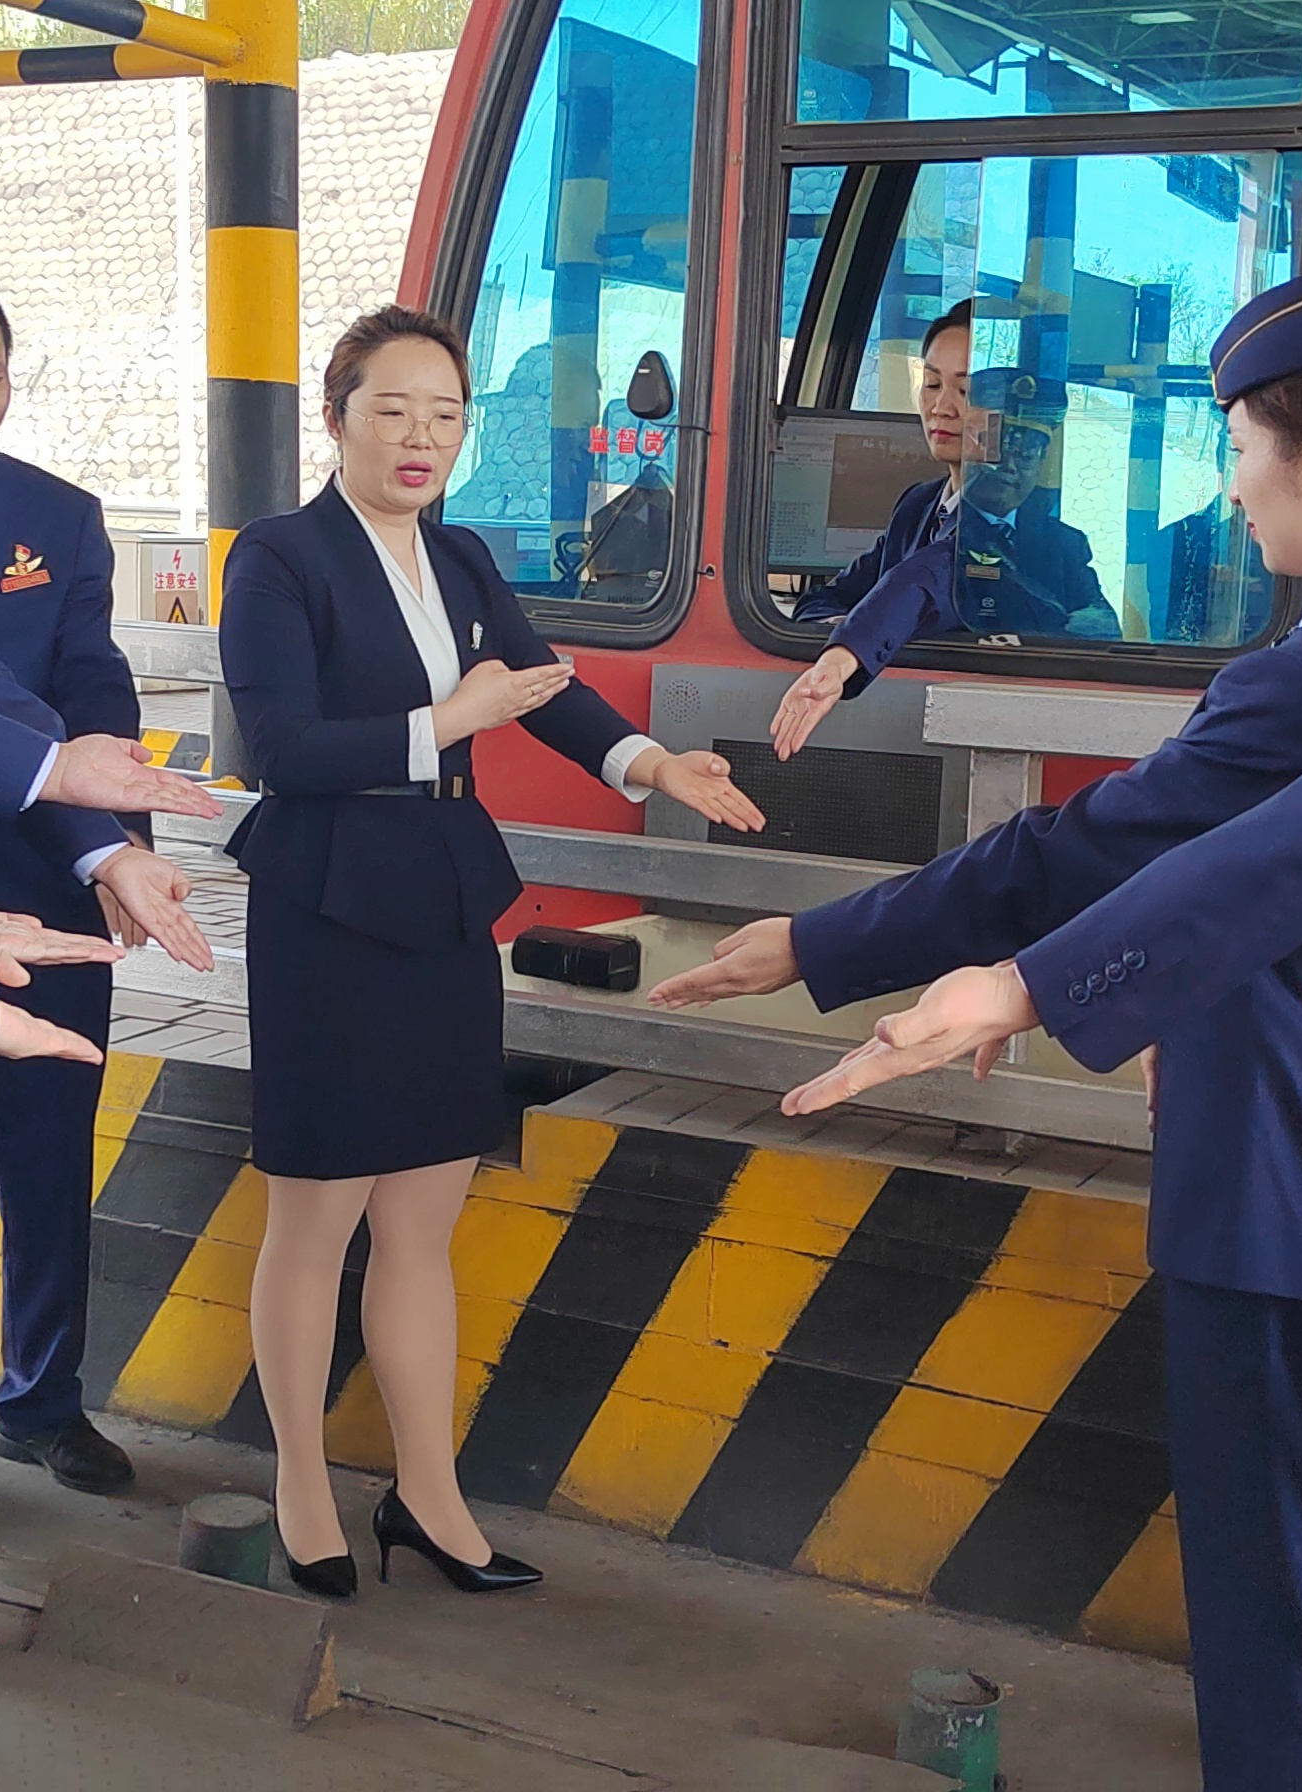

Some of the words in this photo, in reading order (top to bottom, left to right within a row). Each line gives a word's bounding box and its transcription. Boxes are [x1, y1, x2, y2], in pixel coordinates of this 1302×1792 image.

[588, 425, 665, 456] 监督岗
[155, 572, 197, 590] 注意安全
